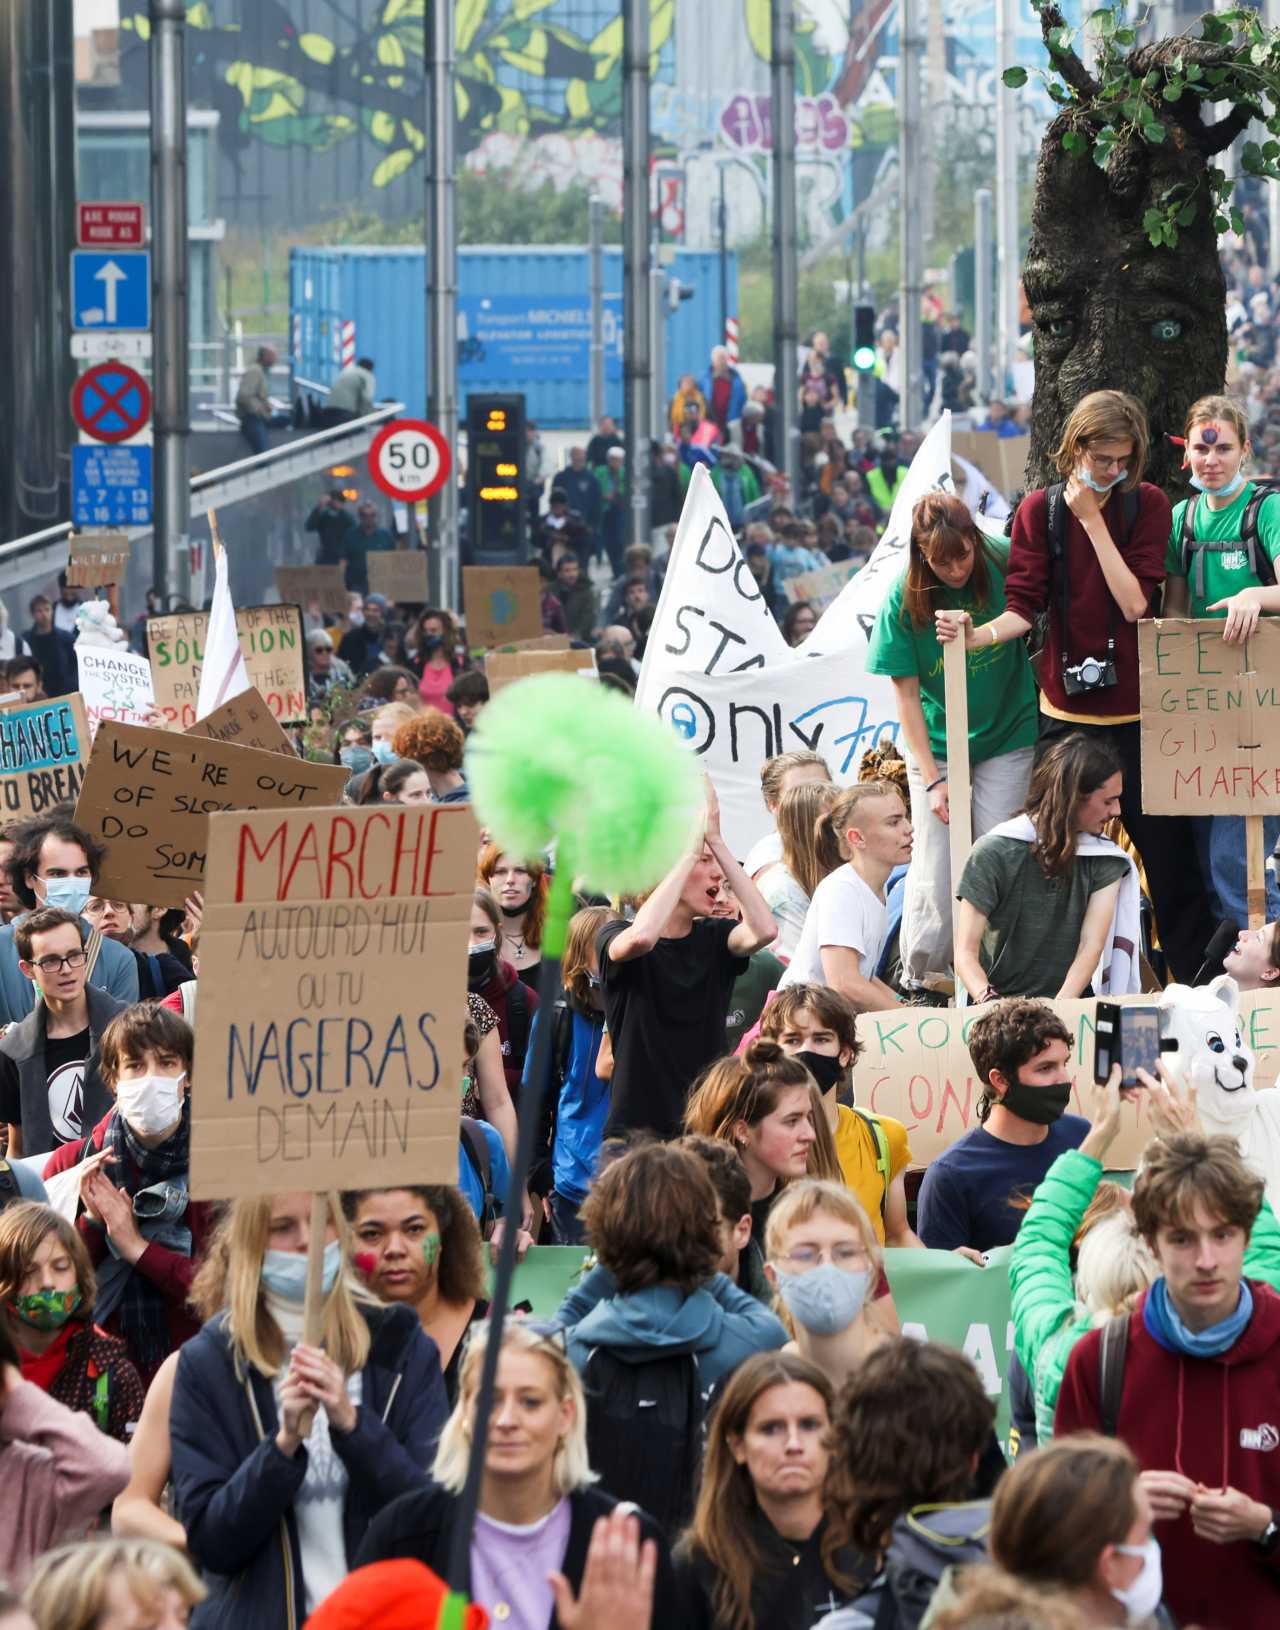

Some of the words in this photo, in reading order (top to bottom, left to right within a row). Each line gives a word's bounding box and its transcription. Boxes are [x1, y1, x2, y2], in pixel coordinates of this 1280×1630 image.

[389, 443, 430, 469] 50
[154, 627, 297, 667] SOLION
[83, 655, 147, 678] CHANGE
[1160, 687, 1243, 713] GEEN
[85, 705, 131, 723] NOT
[113, 786, 156, 808] OF
[256, 774, 319, 801] OUT
[101, 815, 149, 838] DO
[234, 807, 467, 903] MARCHE
[236, 900, 431, 961] AUJOURD'HUI
[336, 970, 364, 1006] TU
[227, 1012, 441, 1101] NAGERAS
[256, 1097, 411, 1164] DEMAIN
